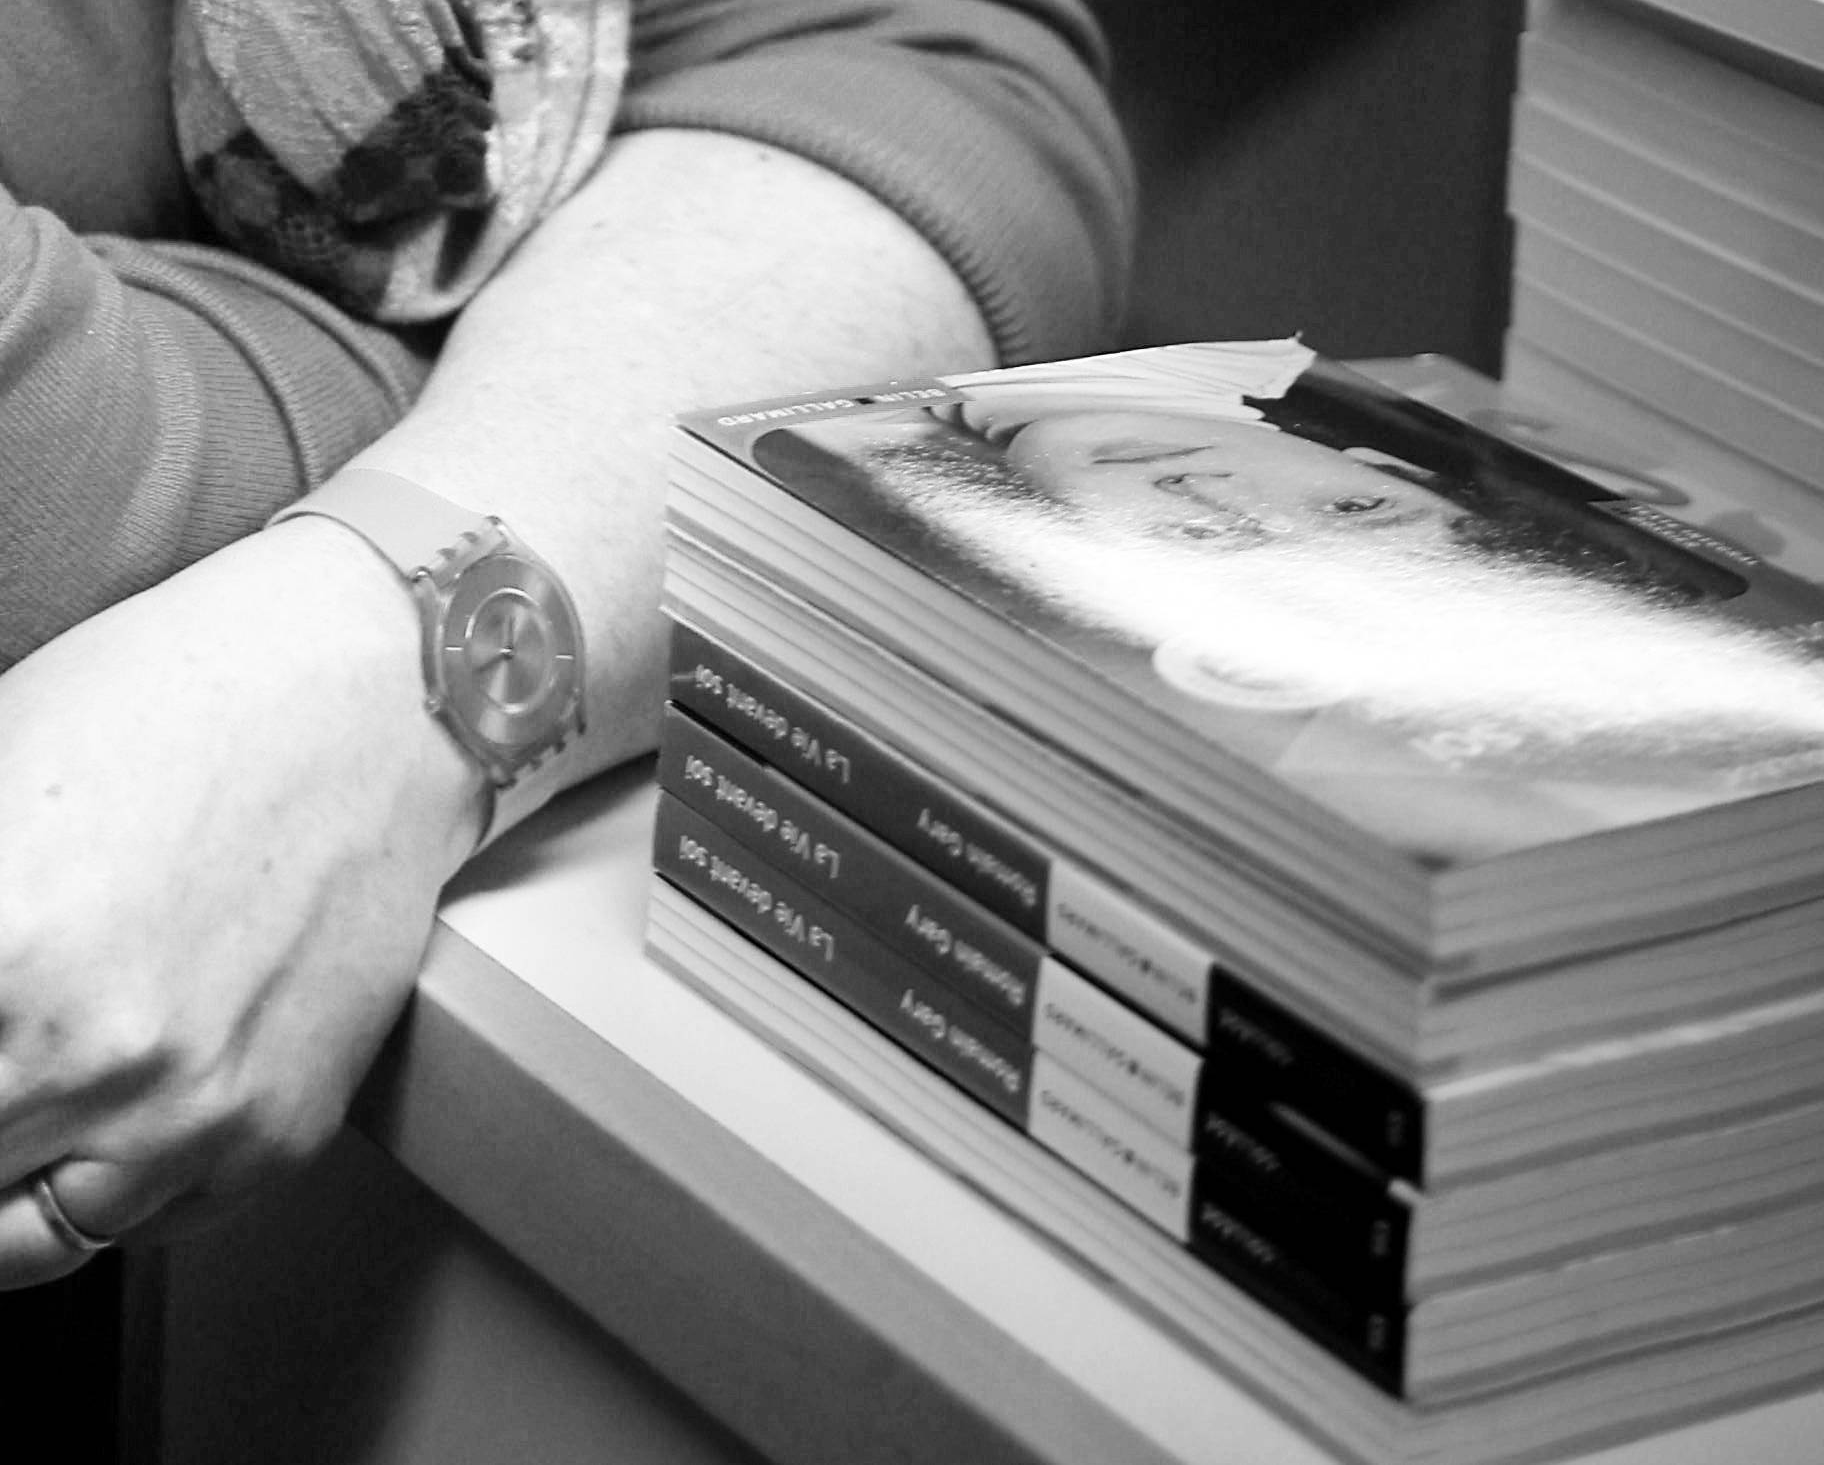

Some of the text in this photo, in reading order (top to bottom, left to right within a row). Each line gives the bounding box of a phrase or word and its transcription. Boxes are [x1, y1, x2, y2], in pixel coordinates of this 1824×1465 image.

[717, 398, 855, 427] GALLIMARD
[694, 663, 851, 785] La Vie devant soi
[685, 754, 840, 880] La Vie devant soi
[917, 808, 963, 857] Gary
[679, 834, 835, 963] La Vie devant soi
[905, 904, 951, 955] Gary
[900, 988, 947, 1039] Gary
